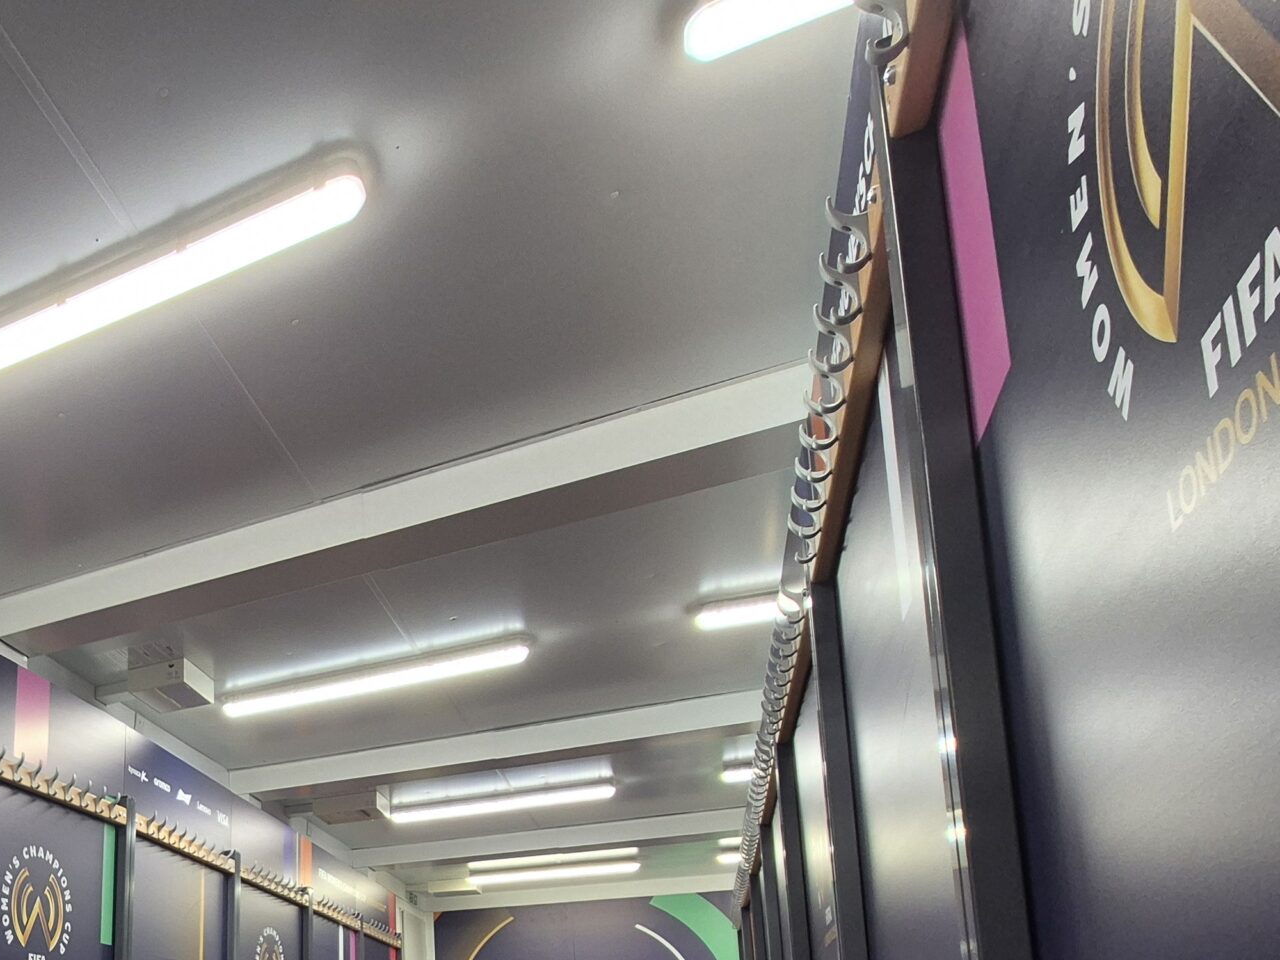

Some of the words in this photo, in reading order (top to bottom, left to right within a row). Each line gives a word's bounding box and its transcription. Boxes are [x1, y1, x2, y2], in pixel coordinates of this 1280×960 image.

[0, 855, 20, 945] WOMEN'S
[22, 844, 73, 913] CHAMPIONS
[59, 921, 72, 955] CUP
